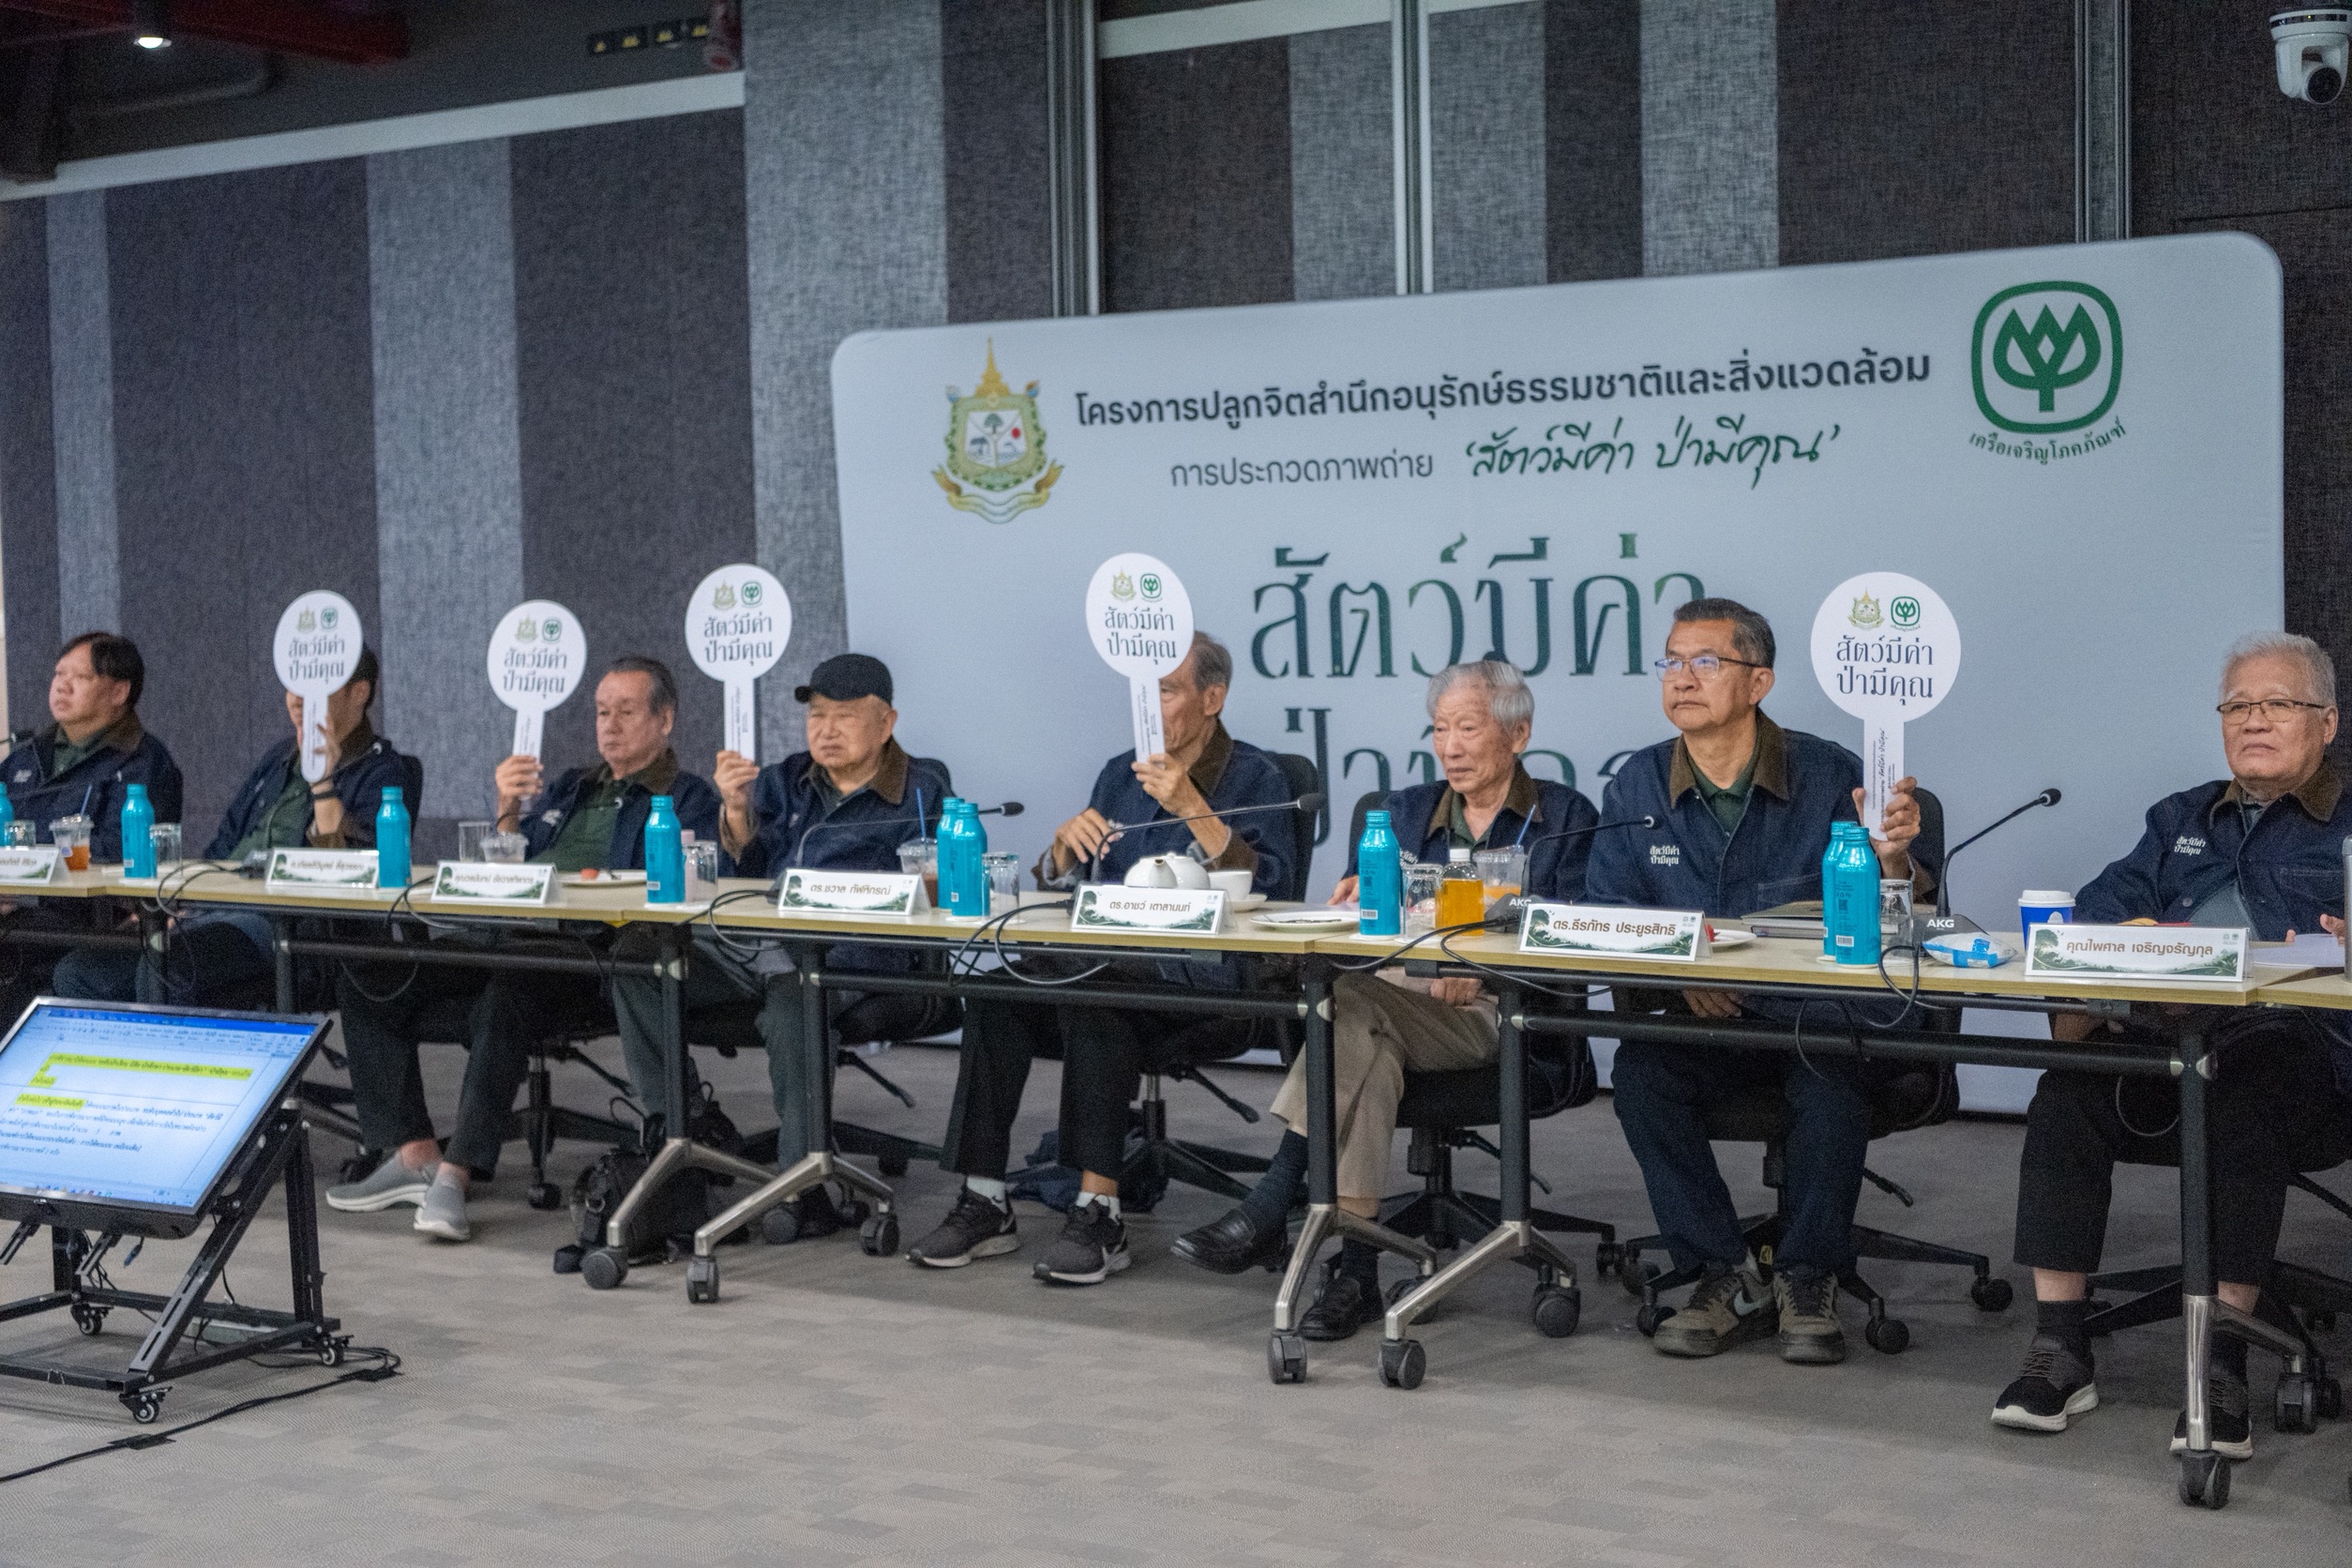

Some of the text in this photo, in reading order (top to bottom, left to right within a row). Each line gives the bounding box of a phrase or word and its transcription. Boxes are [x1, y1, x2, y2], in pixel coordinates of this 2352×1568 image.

[1076, 348, 1930, 430] โครงการปลูกจิตสำนึกอนุรักษ์ธรรมชาติและสิ่งแวดล้อม
[1968, 415, 2127, 465] เครือเจริญโภคภัณฑ์
[1171, 453, 1433, 487] การประกวดภาพถ่าย
[703, 612, 773, 639] สัตว์มีค่า
[1105, 607, 1174, 631] สัตว์มีค่า
[289, 634, 345, 658] สัตว์มีค่า
[504, 646, 567, 669] สัตว์มีค่า
[705, 638, 773, 667] ป่ามีคุณ
[1107, 632, 1177, 665] ป่ามีคุณ
[1836, 635, 1933, 665] สัตว์มีค่า
[289, 657, 344, 685] ป่ามีคุณ
[503, 670, 565, 700] ป่ามีคุณ
[1836, 665, 1933, 706] ป่ามีคุณ
[1650, 845, 1680, 855] สัตว์มีค่า
[1651, 854, 1679, 867] ป่ามีคุณ
[810, 883, 846, 894] ดร.ชวาล
[1109, 900, 1191, 912] ดร.อาชว์ เตาลานนท์
[1553, 918, 1677, 938] ดร.ธีรภัทร ประยูรสิทธิ
[1927, 919, 1955, 928] AKG
[2066, 939, 2213, 957] คุณไพศาล เจริญจรัญกุล
